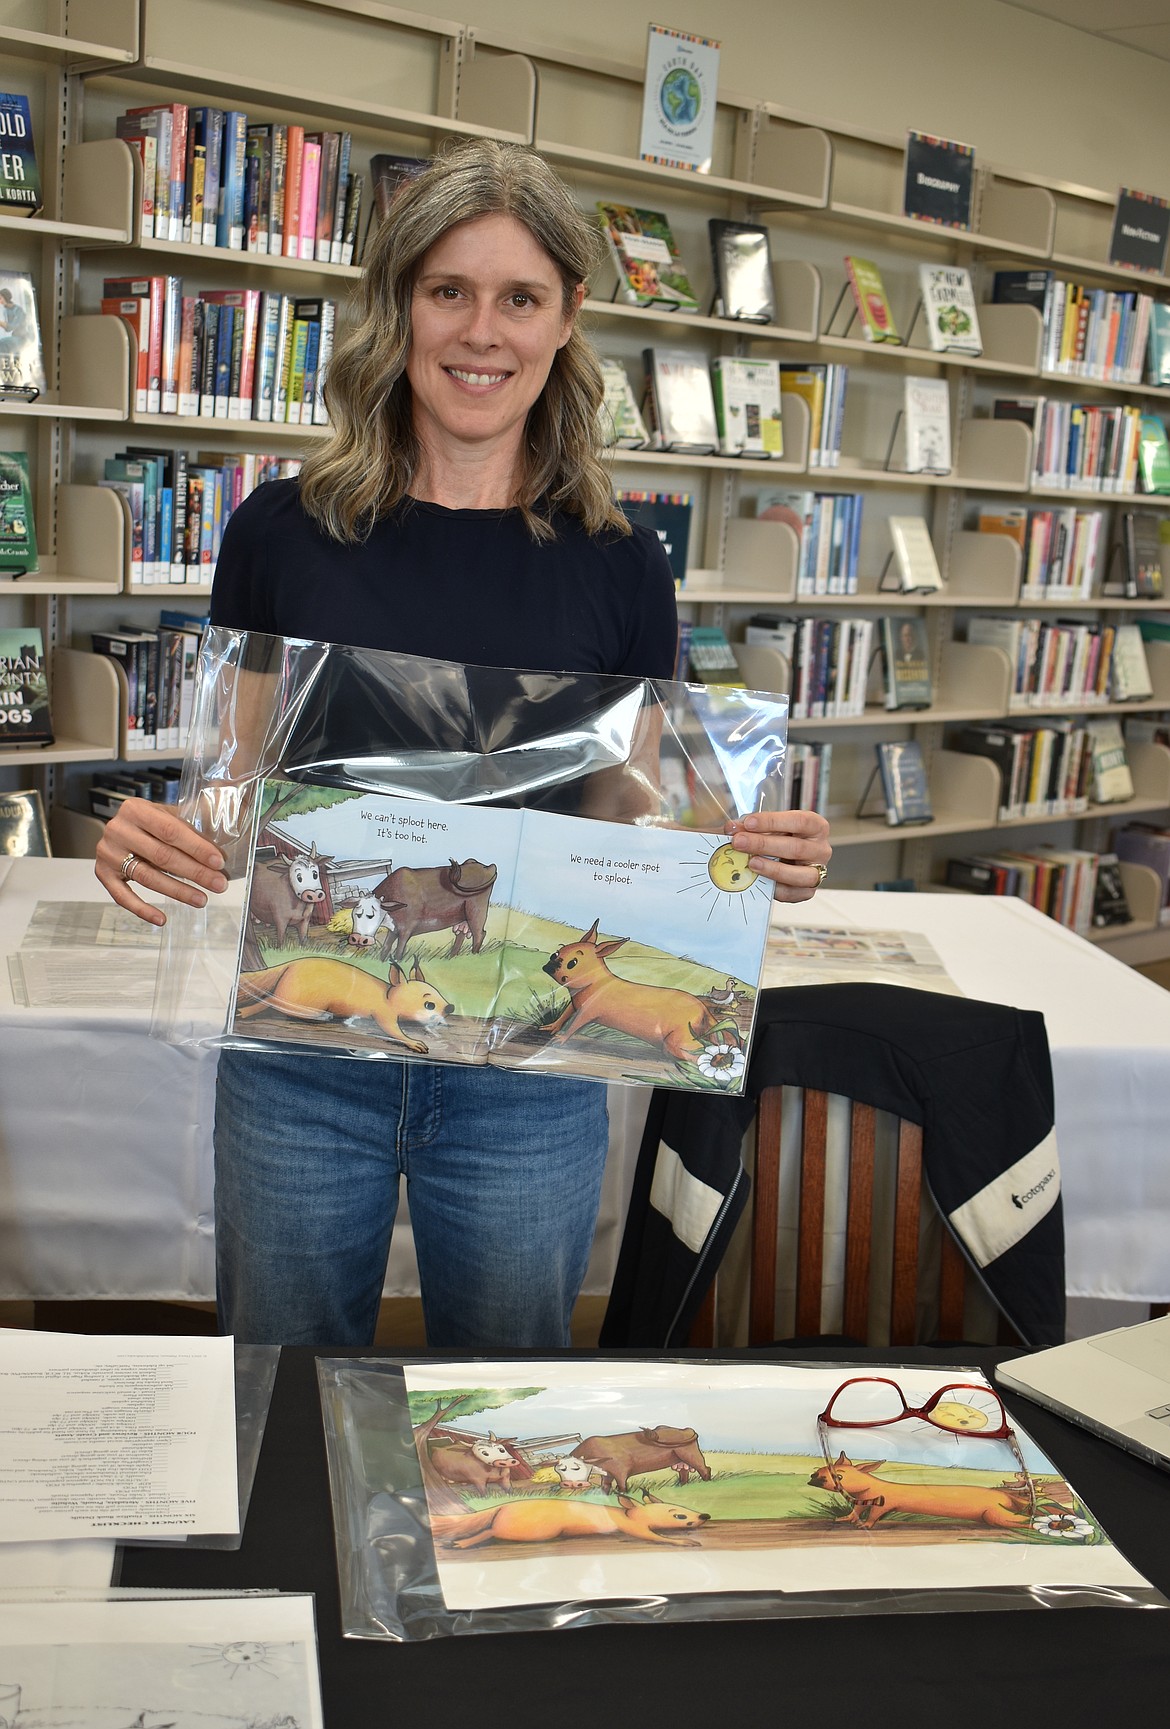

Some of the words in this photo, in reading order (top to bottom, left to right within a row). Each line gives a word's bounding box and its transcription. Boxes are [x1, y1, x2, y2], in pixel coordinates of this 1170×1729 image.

[6, 188, 36, 202] KORYTA
[322, 302, 335, 331] JOHN
[176, 472, 187, 506] ANCIENT
[204, 482, 213, 516] FAKER
[176, 509, 185, 529] NINE
[360, 810, 372, 820] We
[374, 814, 396, 824] can't
[398, 816, 424, 828] sploot
[427, 819, 449, 831] here.
[395, 831, 409, 840] too
[412, 832, 427, 844] hot.
[570, 854, 581, 863] We
[584, 857, 604, 867] need
[614, 860, 639, 870] cooler
[641, 864, 660, 874] spot
[594, 872, 603, 880] to
[605, 873, 632, 885] sploot.
